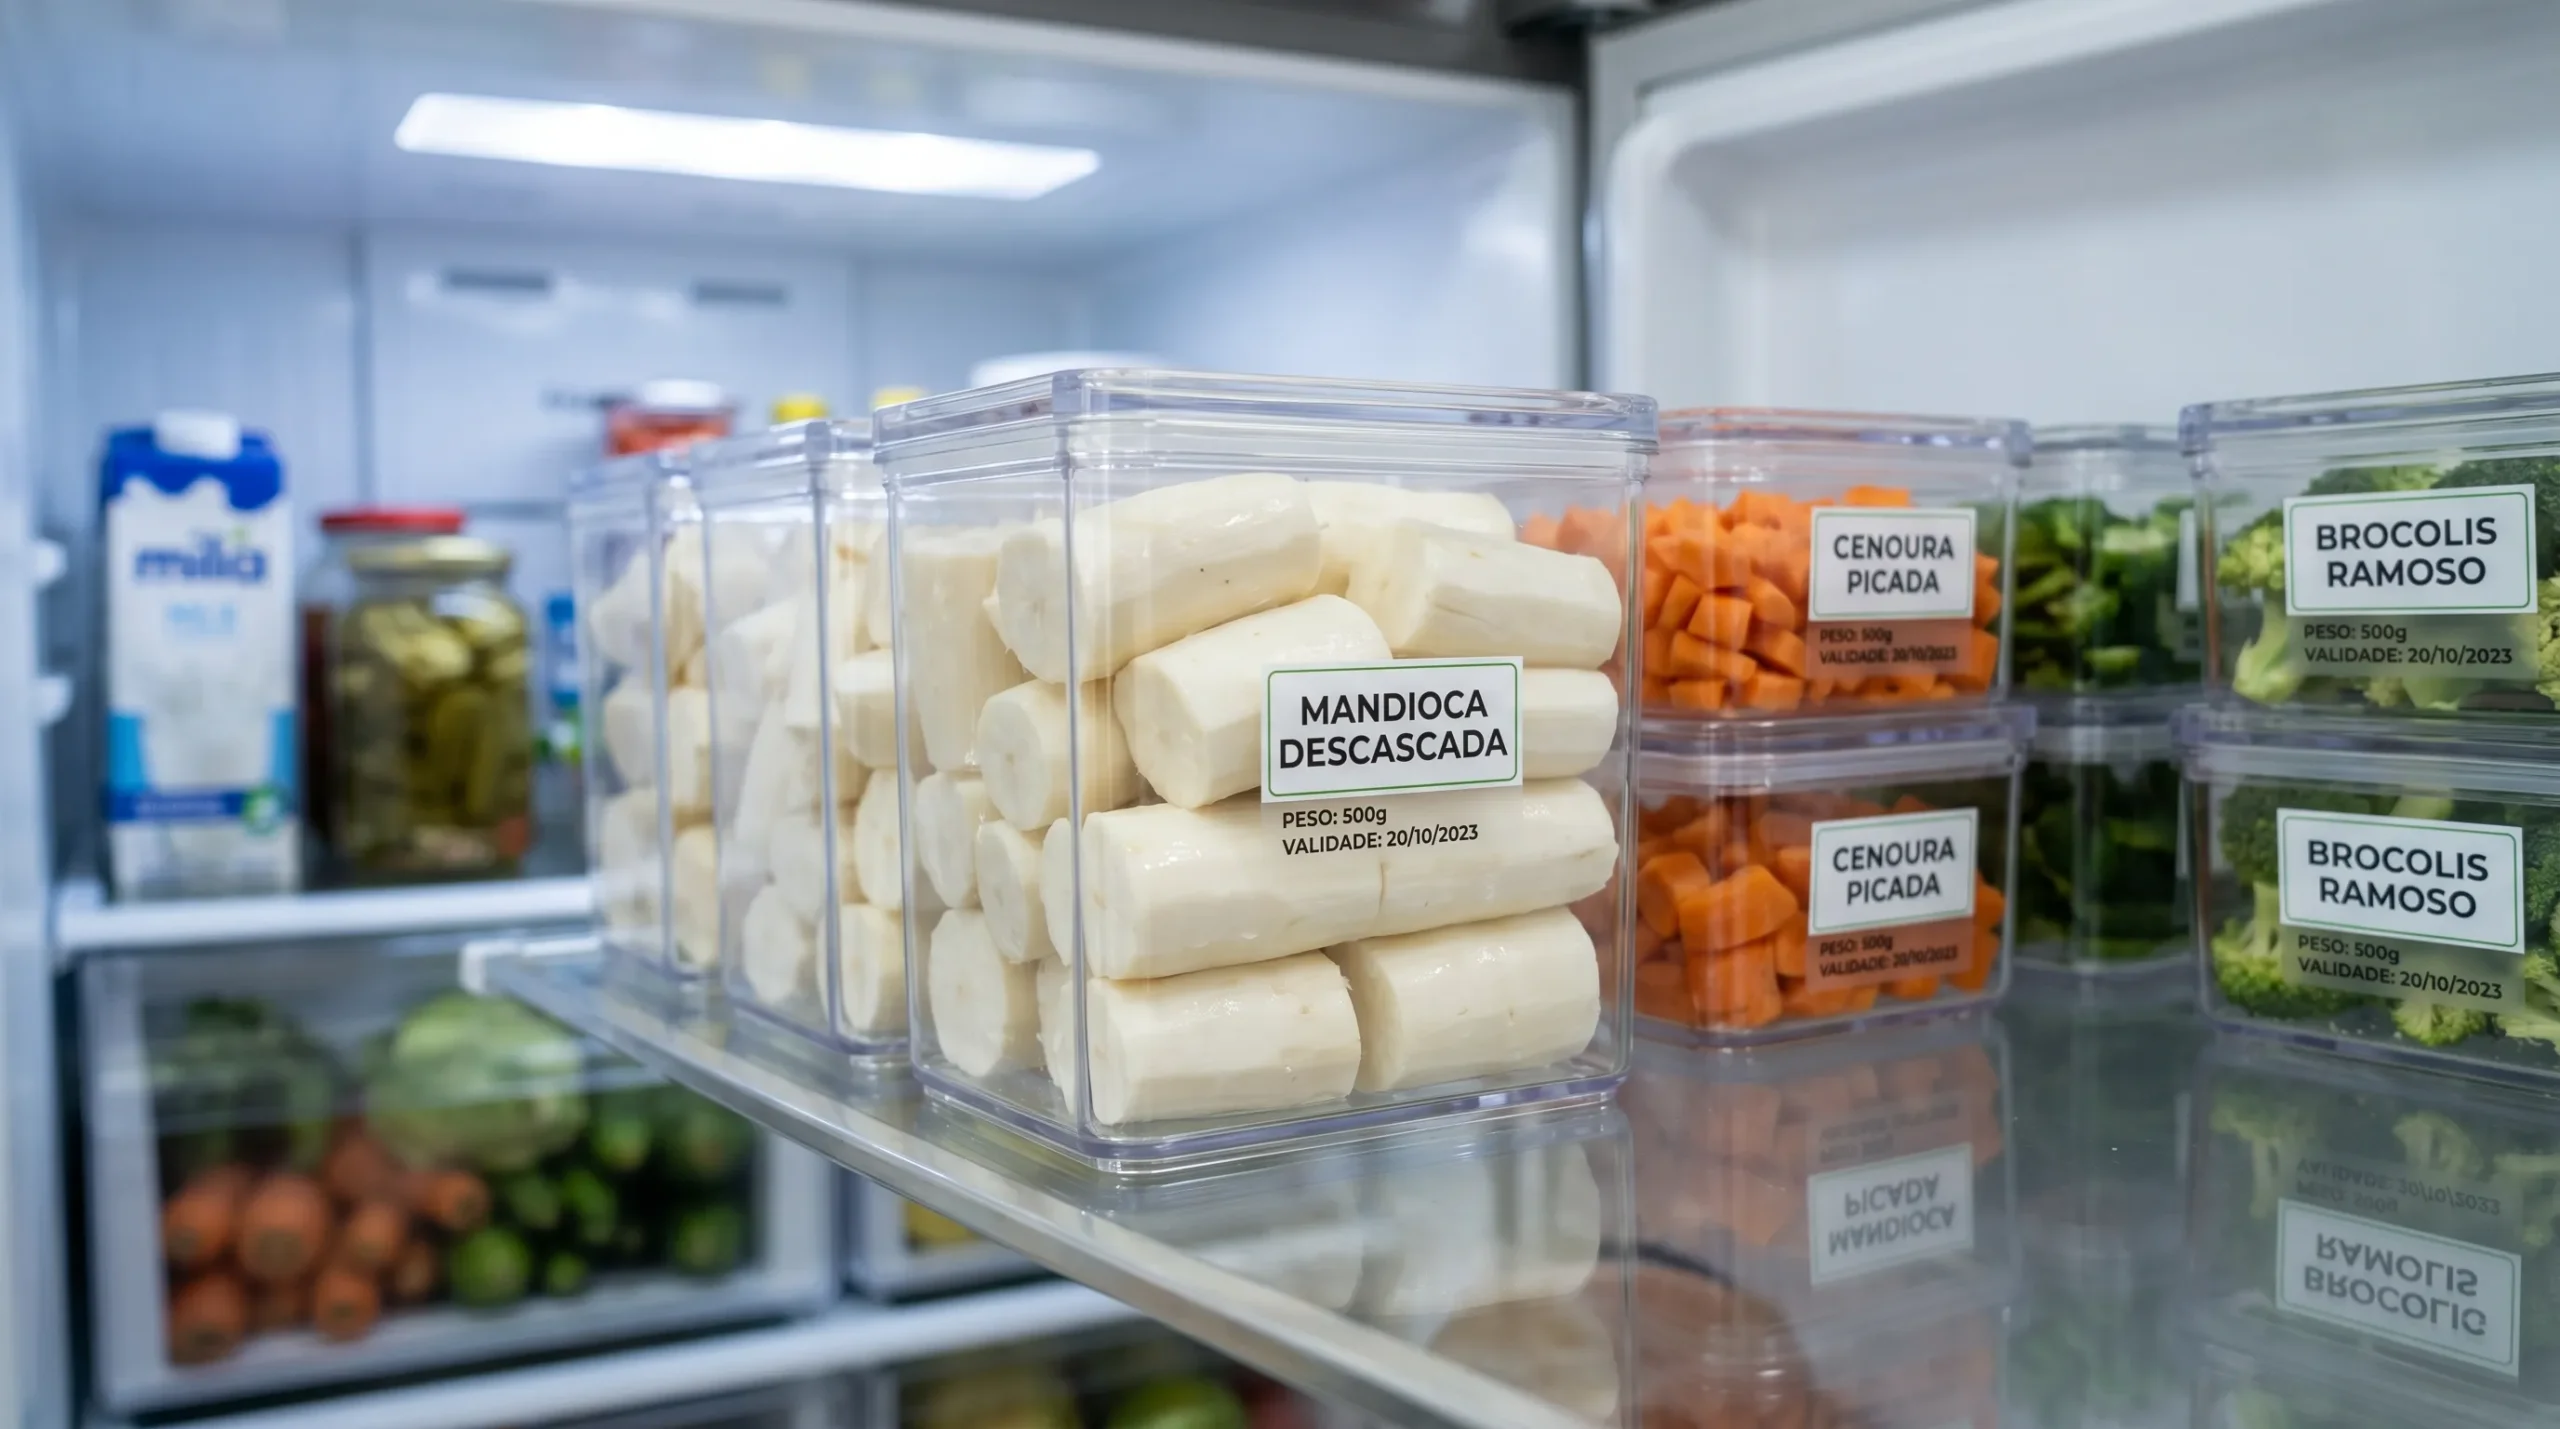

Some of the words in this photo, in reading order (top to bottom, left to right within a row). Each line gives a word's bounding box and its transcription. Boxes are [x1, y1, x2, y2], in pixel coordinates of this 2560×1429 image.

[1833, 534, 1955, 560] CENOURA
[2316, 516, 2498, 551] BROCOLIS
[1847, 569, 1940, 594] PICADA
[2327, 556, 2486, 588] RAMOSO
[1820, 628, 1857, 643] PESO:
[2304, 623, 2356, 640] PESO:
[2360, 623, 2408, 644] 500g
[2304, 646, 2403, 664] VALIDADE:
[2408, 645, 2513, 666] 20/10/2023
[1301, 689, 1489, 726] MANDIOCA
[1279, 727, 1508, 769] DESCASCADA
[1282, 809, 1338, 829] PESO:
[1342, 805, 1388, 825] 500g
[1282, 832, 1383, 855] VALIDADE:
[1386, 824, 1479, 848] 20/10/2023
[1832, 836, 1956, 873] CENOURA
[2308, 839, 2489, 882] BROCOLIS
[1846, 872, 1941, 905] PICADA
[2319, 877, 2477, 919] RAMOSO
[2298, 934, 2350, 957] PESO:
[2354, 941, 2400, 965] 500g
[2298, 957, 2396, 985] VALIDADE:
[2400, 971, 2503, 1000] 20/10/2023
